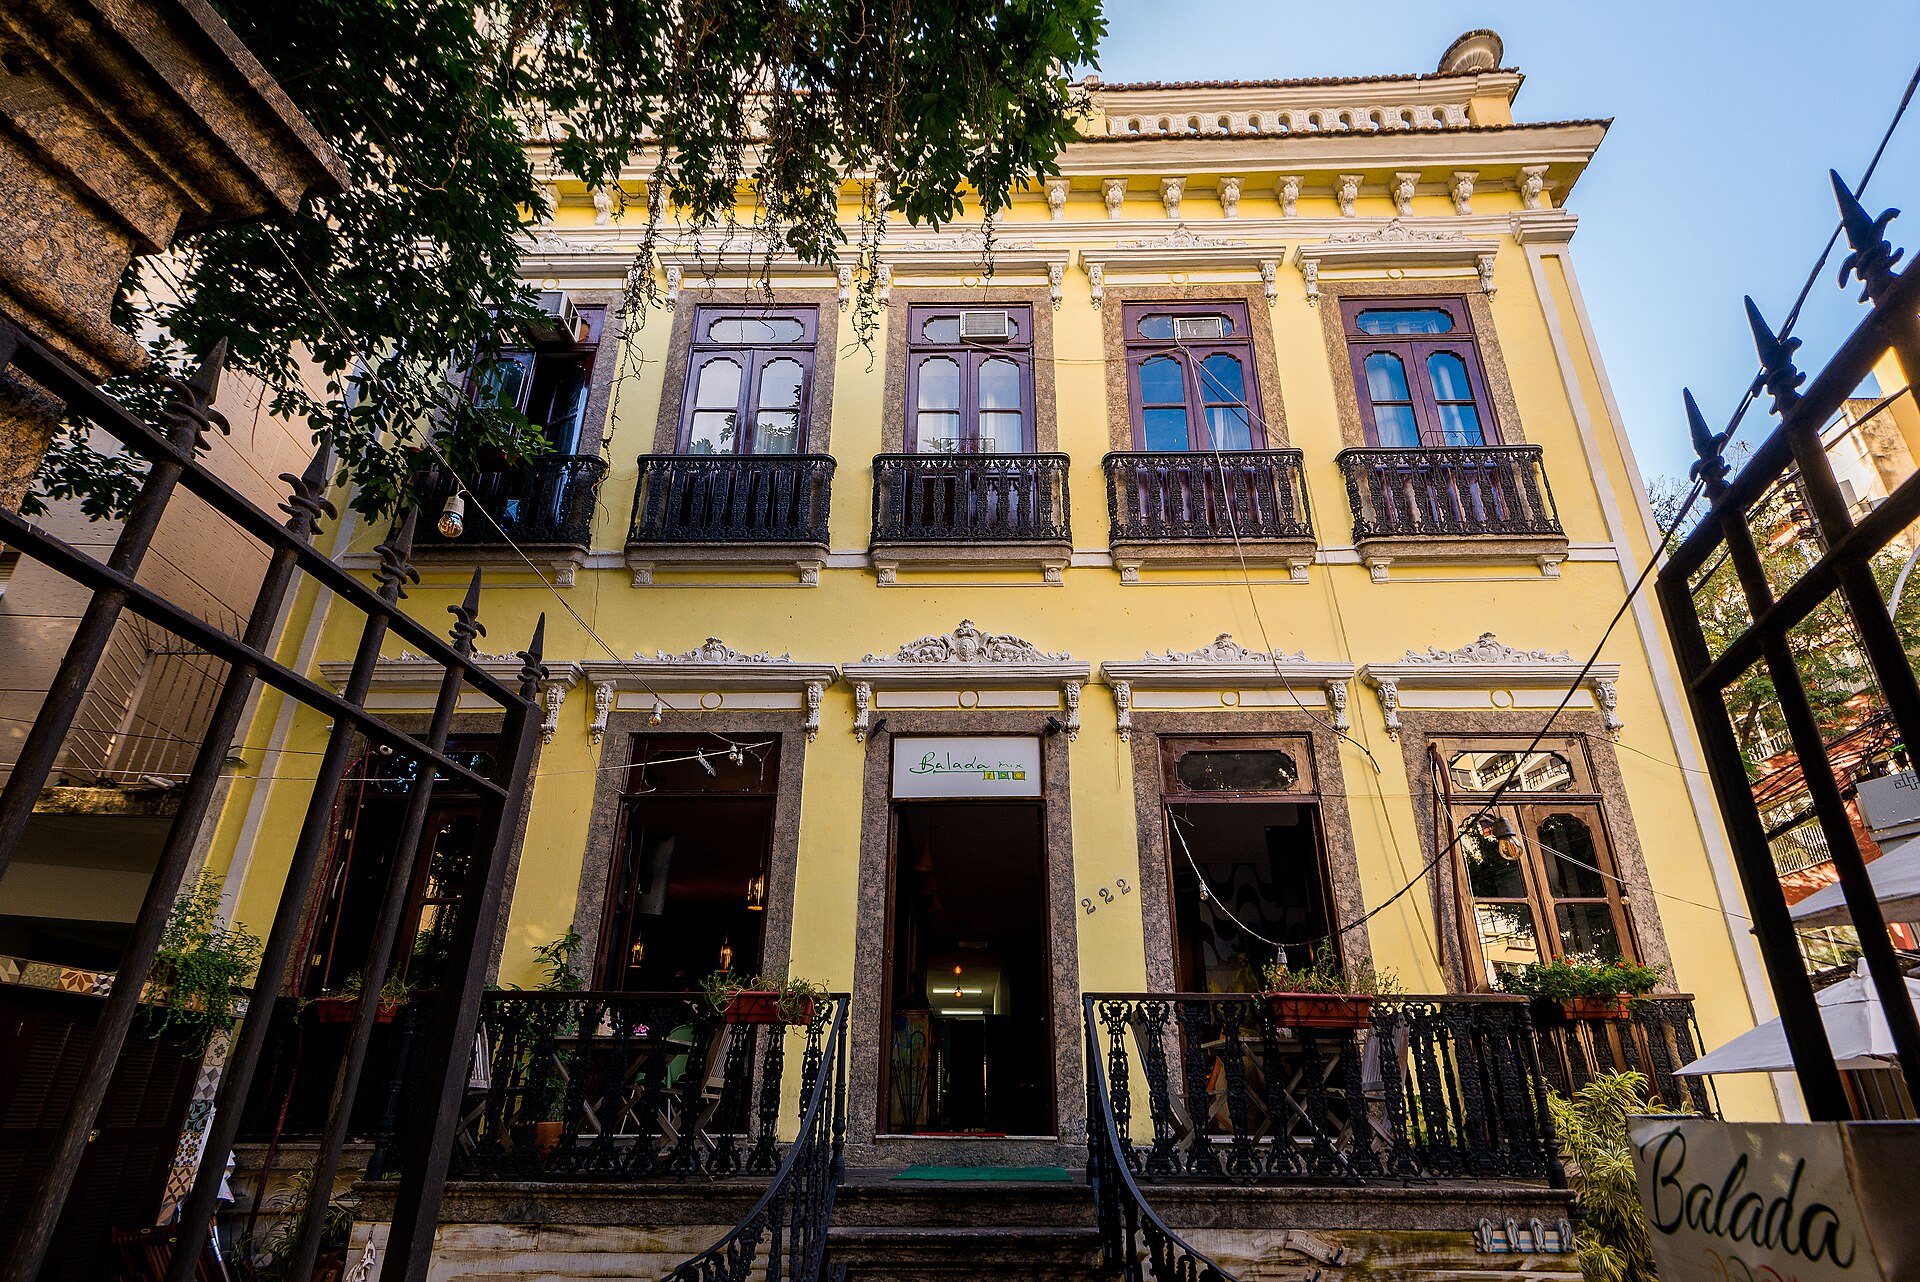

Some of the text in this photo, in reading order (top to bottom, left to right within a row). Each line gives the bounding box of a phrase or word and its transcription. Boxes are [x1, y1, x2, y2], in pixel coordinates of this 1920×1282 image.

[909, 751, 990, 774] Balada
[1081, 878, 1132, 915] 222
[1640, 1125, 1856, 1269] Balada
[1293, 1234, 1328, 1258] WELCOME
